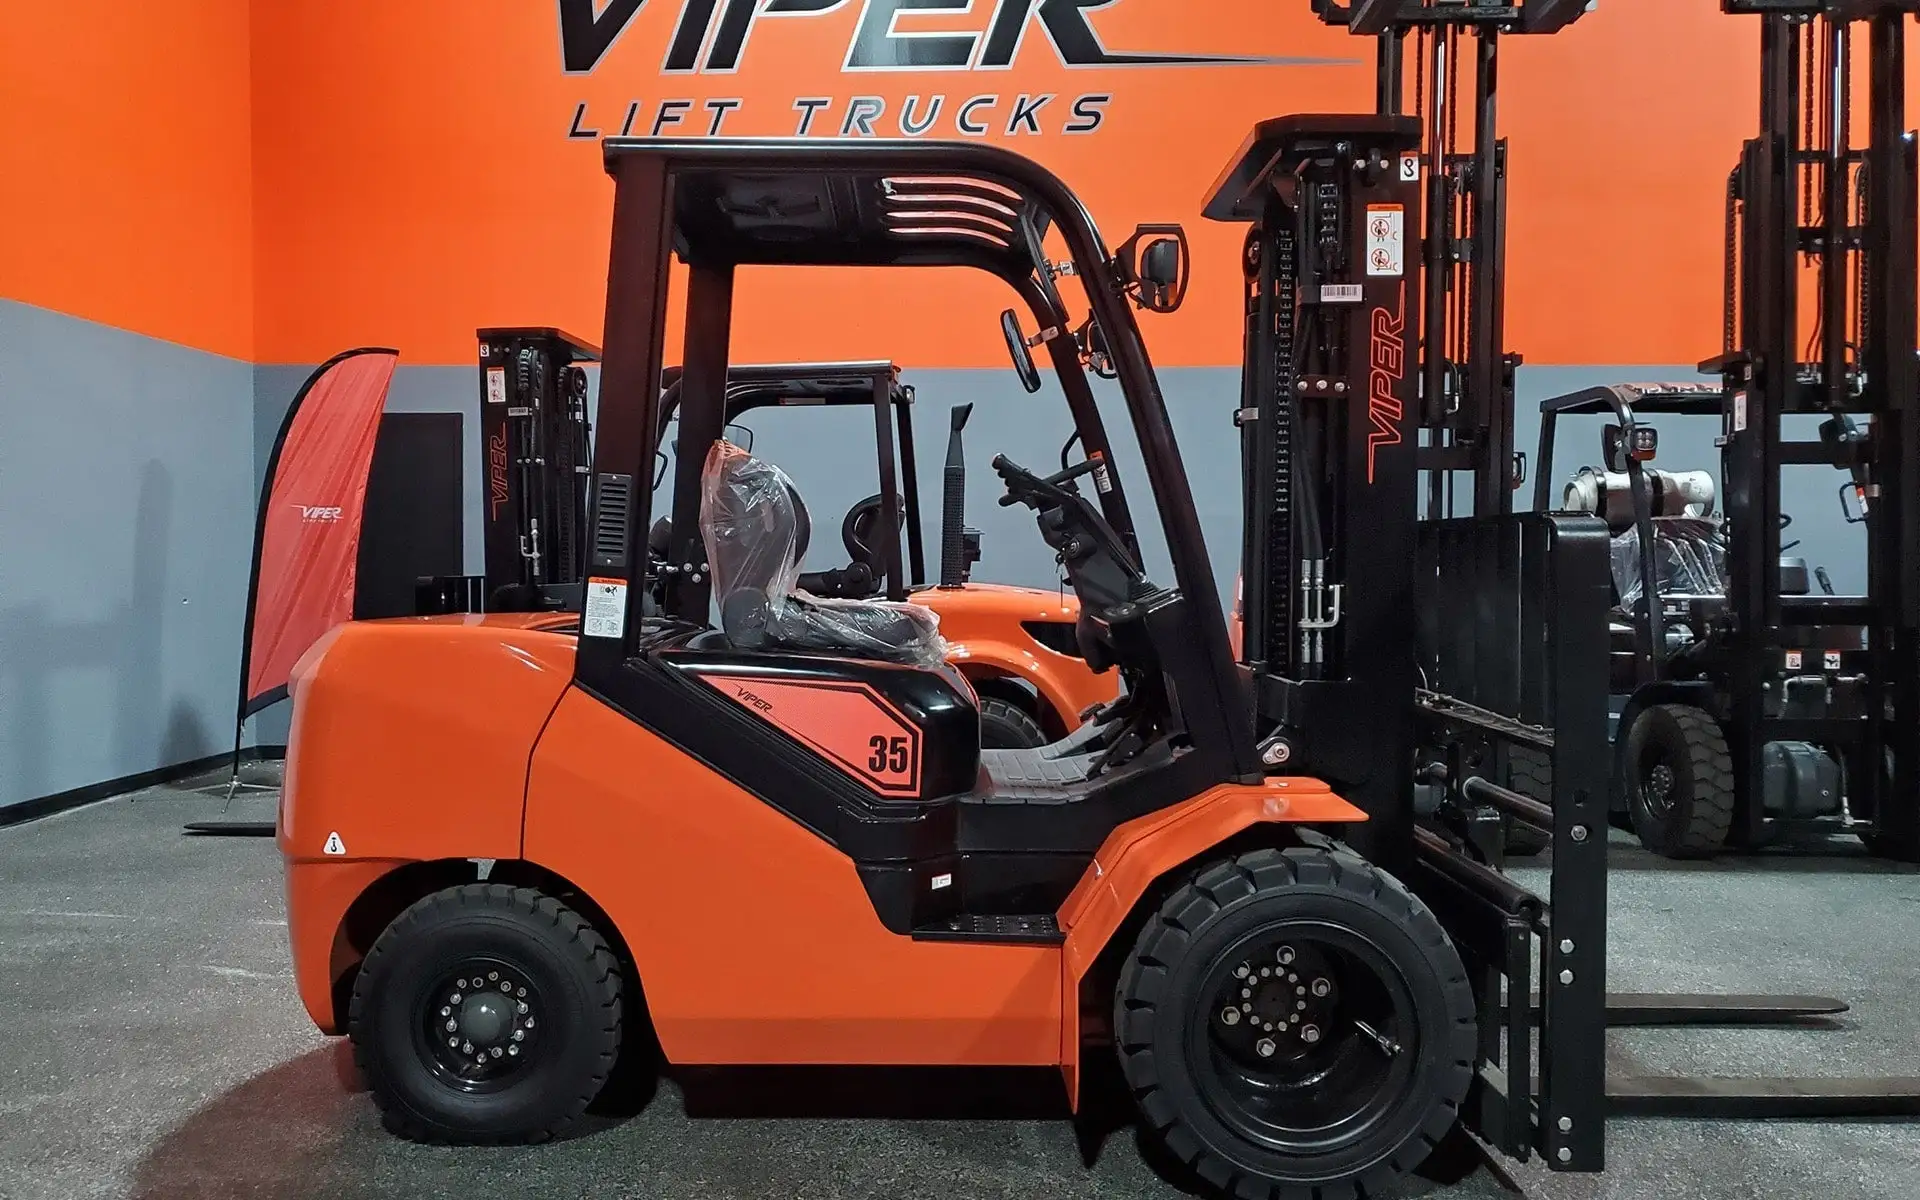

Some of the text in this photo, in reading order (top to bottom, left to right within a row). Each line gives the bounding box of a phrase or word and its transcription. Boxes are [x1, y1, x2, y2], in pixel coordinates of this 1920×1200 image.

[567, 94, 1114, 140] LIFT TRUCKS
[1369, 280, 1405, 485] VIPER
[490, 421, 508, 521] VIPER
[291, 504, 344, 519] VIPER
[733, 683, 774, 713] VIPER
[868, 735, 908, 773] 35
